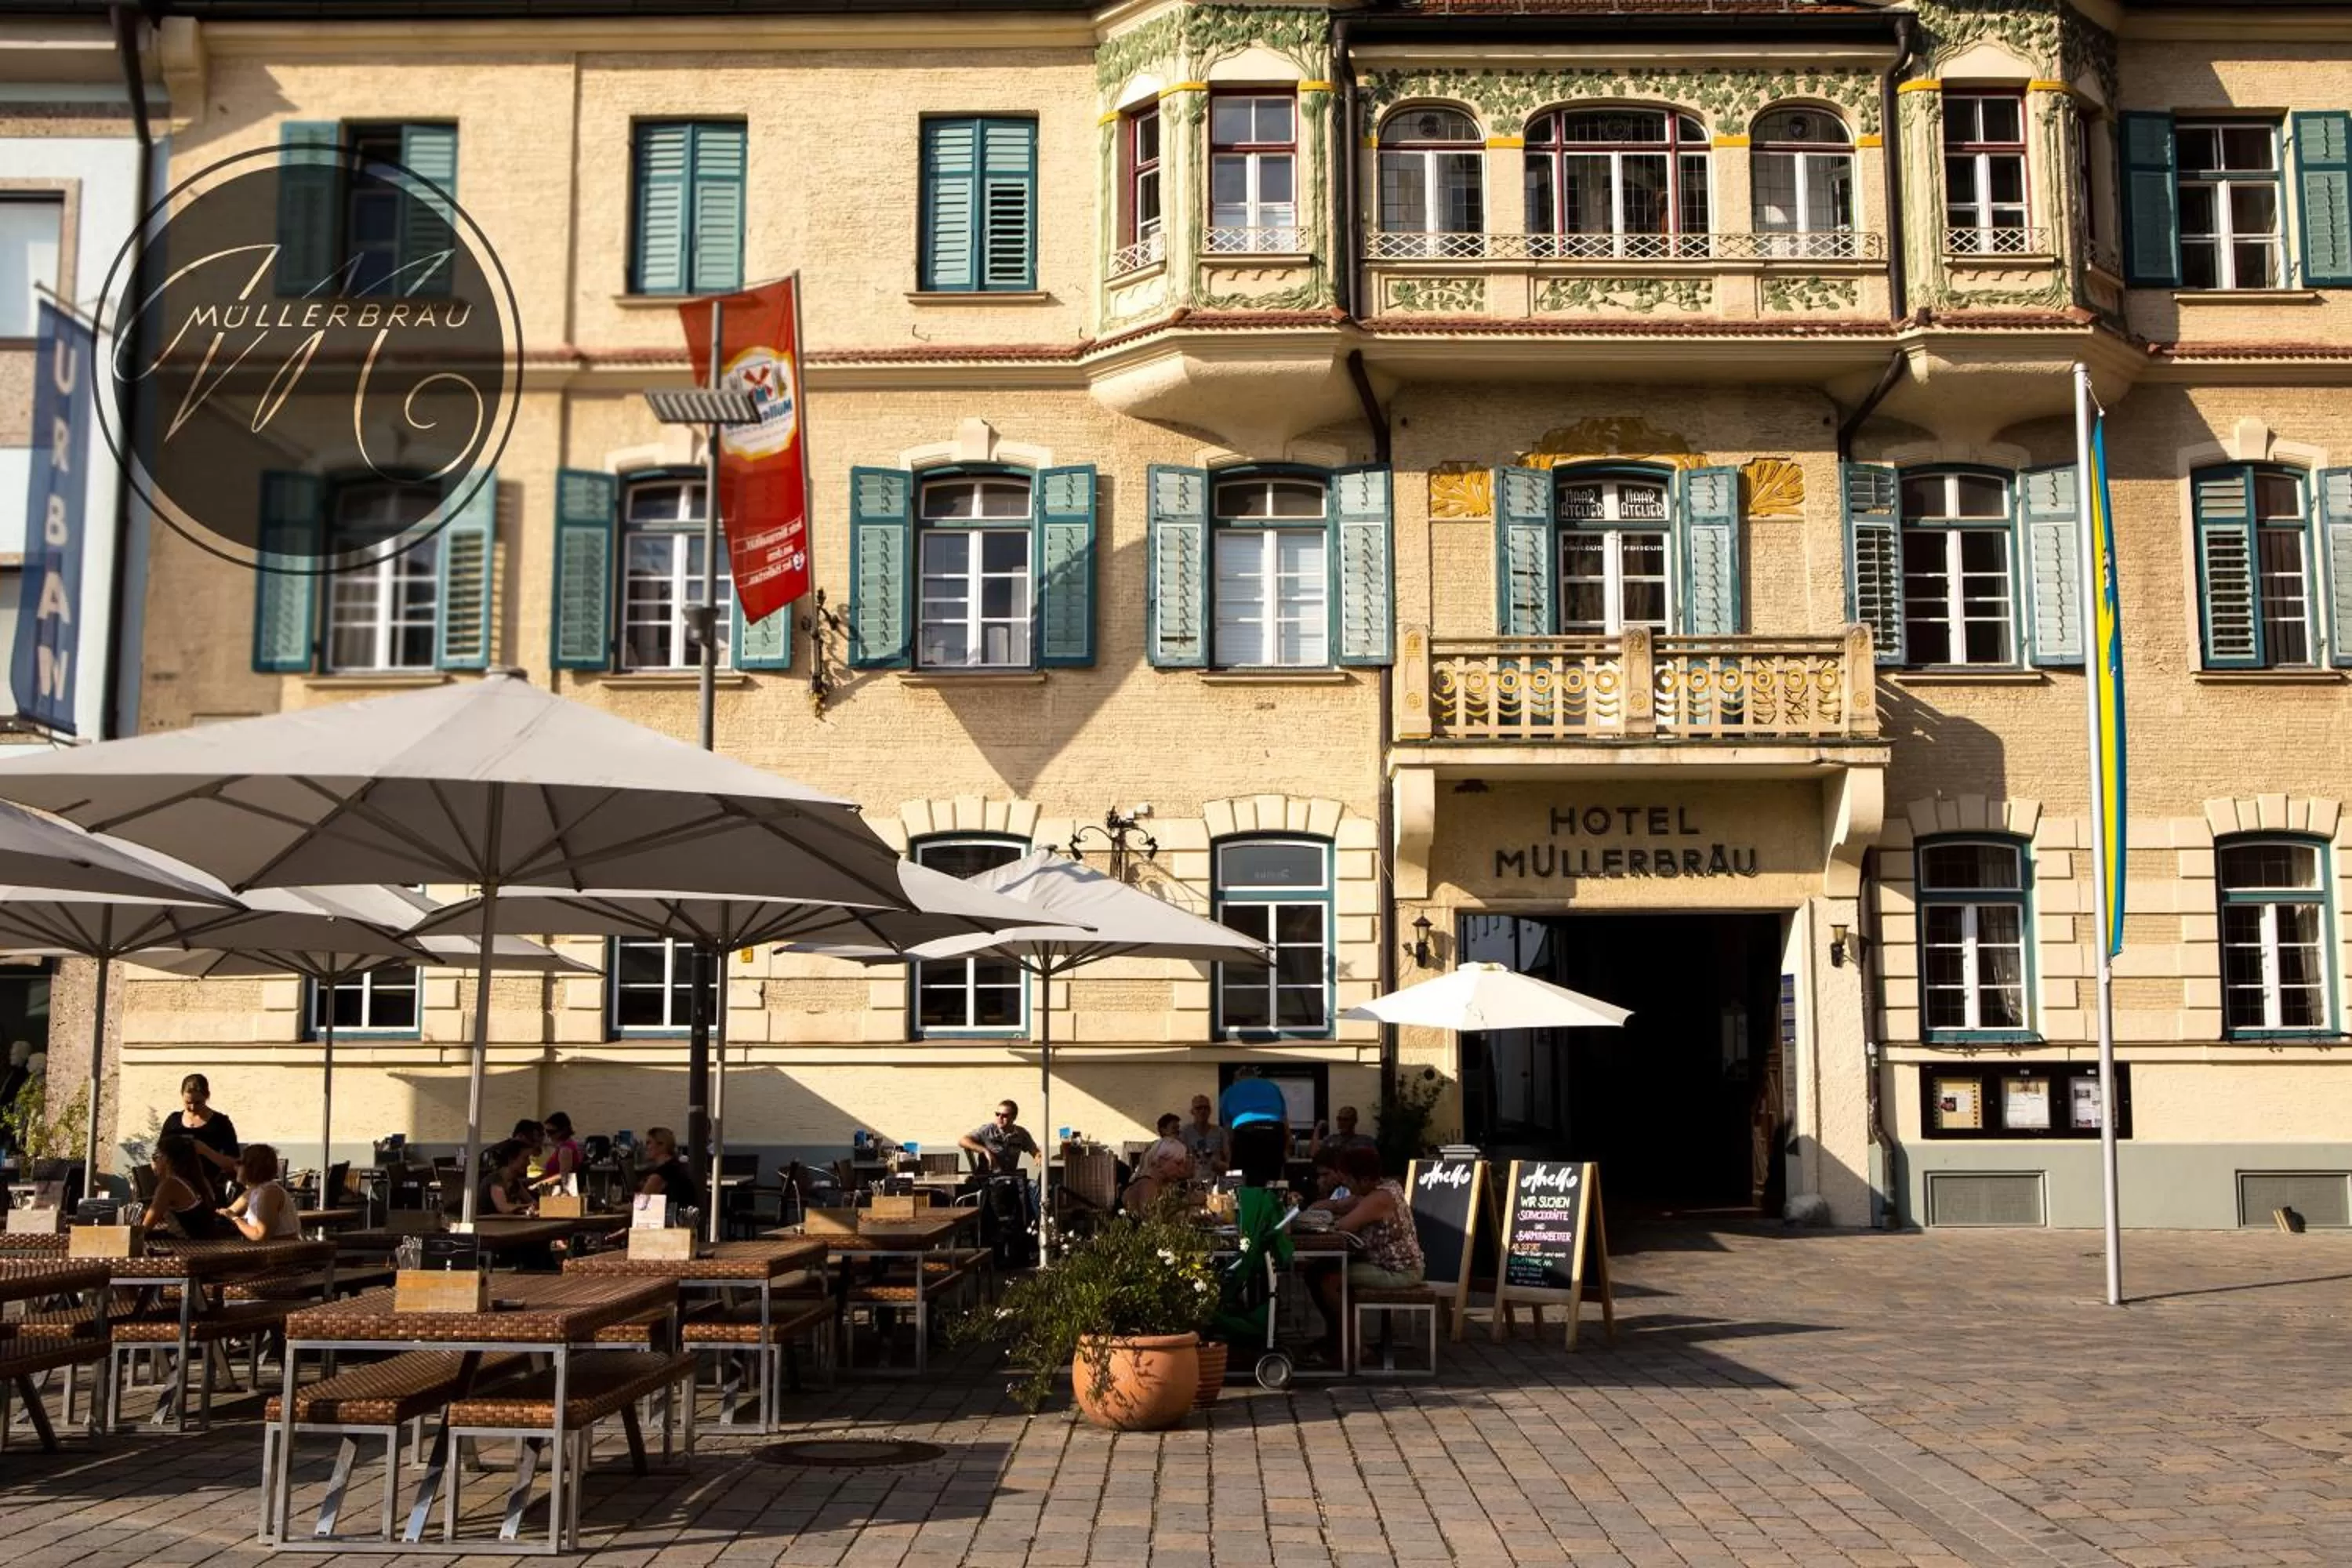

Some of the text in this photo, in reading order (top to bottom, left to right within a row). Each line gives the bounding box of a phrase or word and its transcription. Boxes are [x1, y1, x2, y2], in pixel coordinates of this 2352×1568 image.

[1621, 502, 1664, 517] ATELIER
[1625, 488, 1656, 503] HAAR
[36, 338, 77, 702] URBAN
[1550, 807, 1700, 836] HOTEL
[1494, 844, 1758, 878] MÜLLERBRÄU
